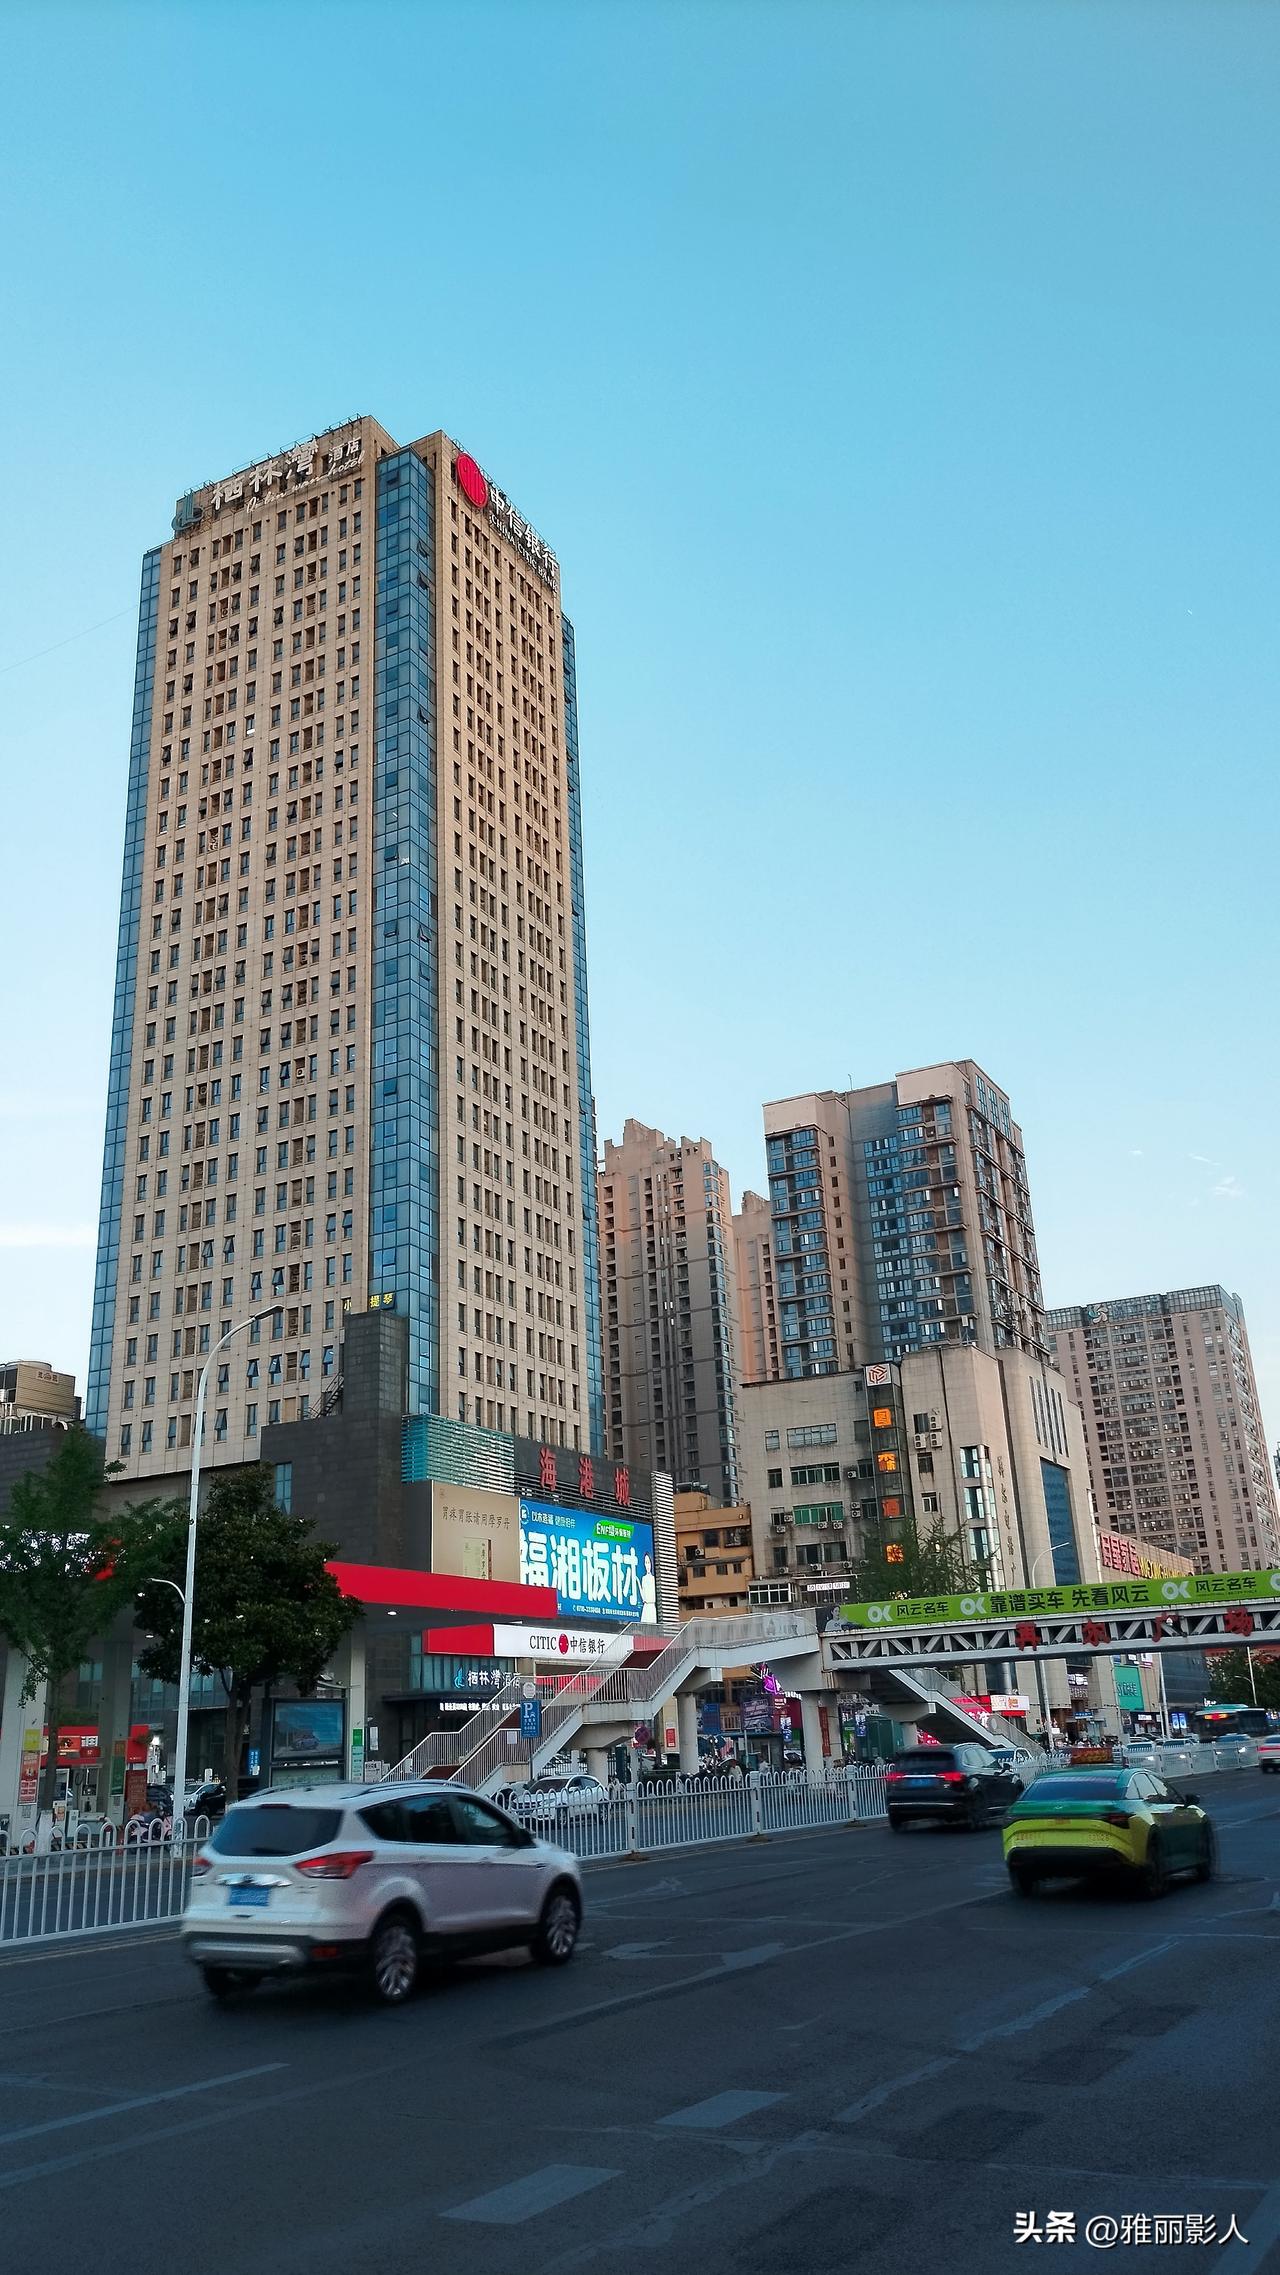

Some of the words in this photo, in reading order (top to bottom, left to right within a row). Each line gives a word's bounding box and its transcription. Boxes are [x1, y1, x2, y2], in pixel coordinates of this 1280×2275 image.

[211, 438, 319, 511] 栖林灣
[328, 437, 362, 462] 酒店
[328, 450, 366, 478] hotel
[490, 487, 559, 577] 中信银行
[491, 514, 516, 545] CHINA
[517, 543, 537, 570] CITIC
[538, 567, 559, 594] BANK
[539, 1447, 632, 1507] 海港城
[520, 1528, 639, 1604] 福湘板材
[960, 1597, 987, 1616] OK
[990, 1591, 1064, 1614] 靠谱买车
[1072, 1584, 1149, 1608] 先看风云
[1162, 1581, 1192, 1600] OK
[1196, 1577, 1257, 1593] 风云名车
[868, 1605, 893, 1622] OK
[897, 1601, 949, 1617] 风云名车
[529, 1635, 557, 1651] CITIC
[570, 1636, 605, 1654] 中信银行
[523, 1703, 533, 1718] P
